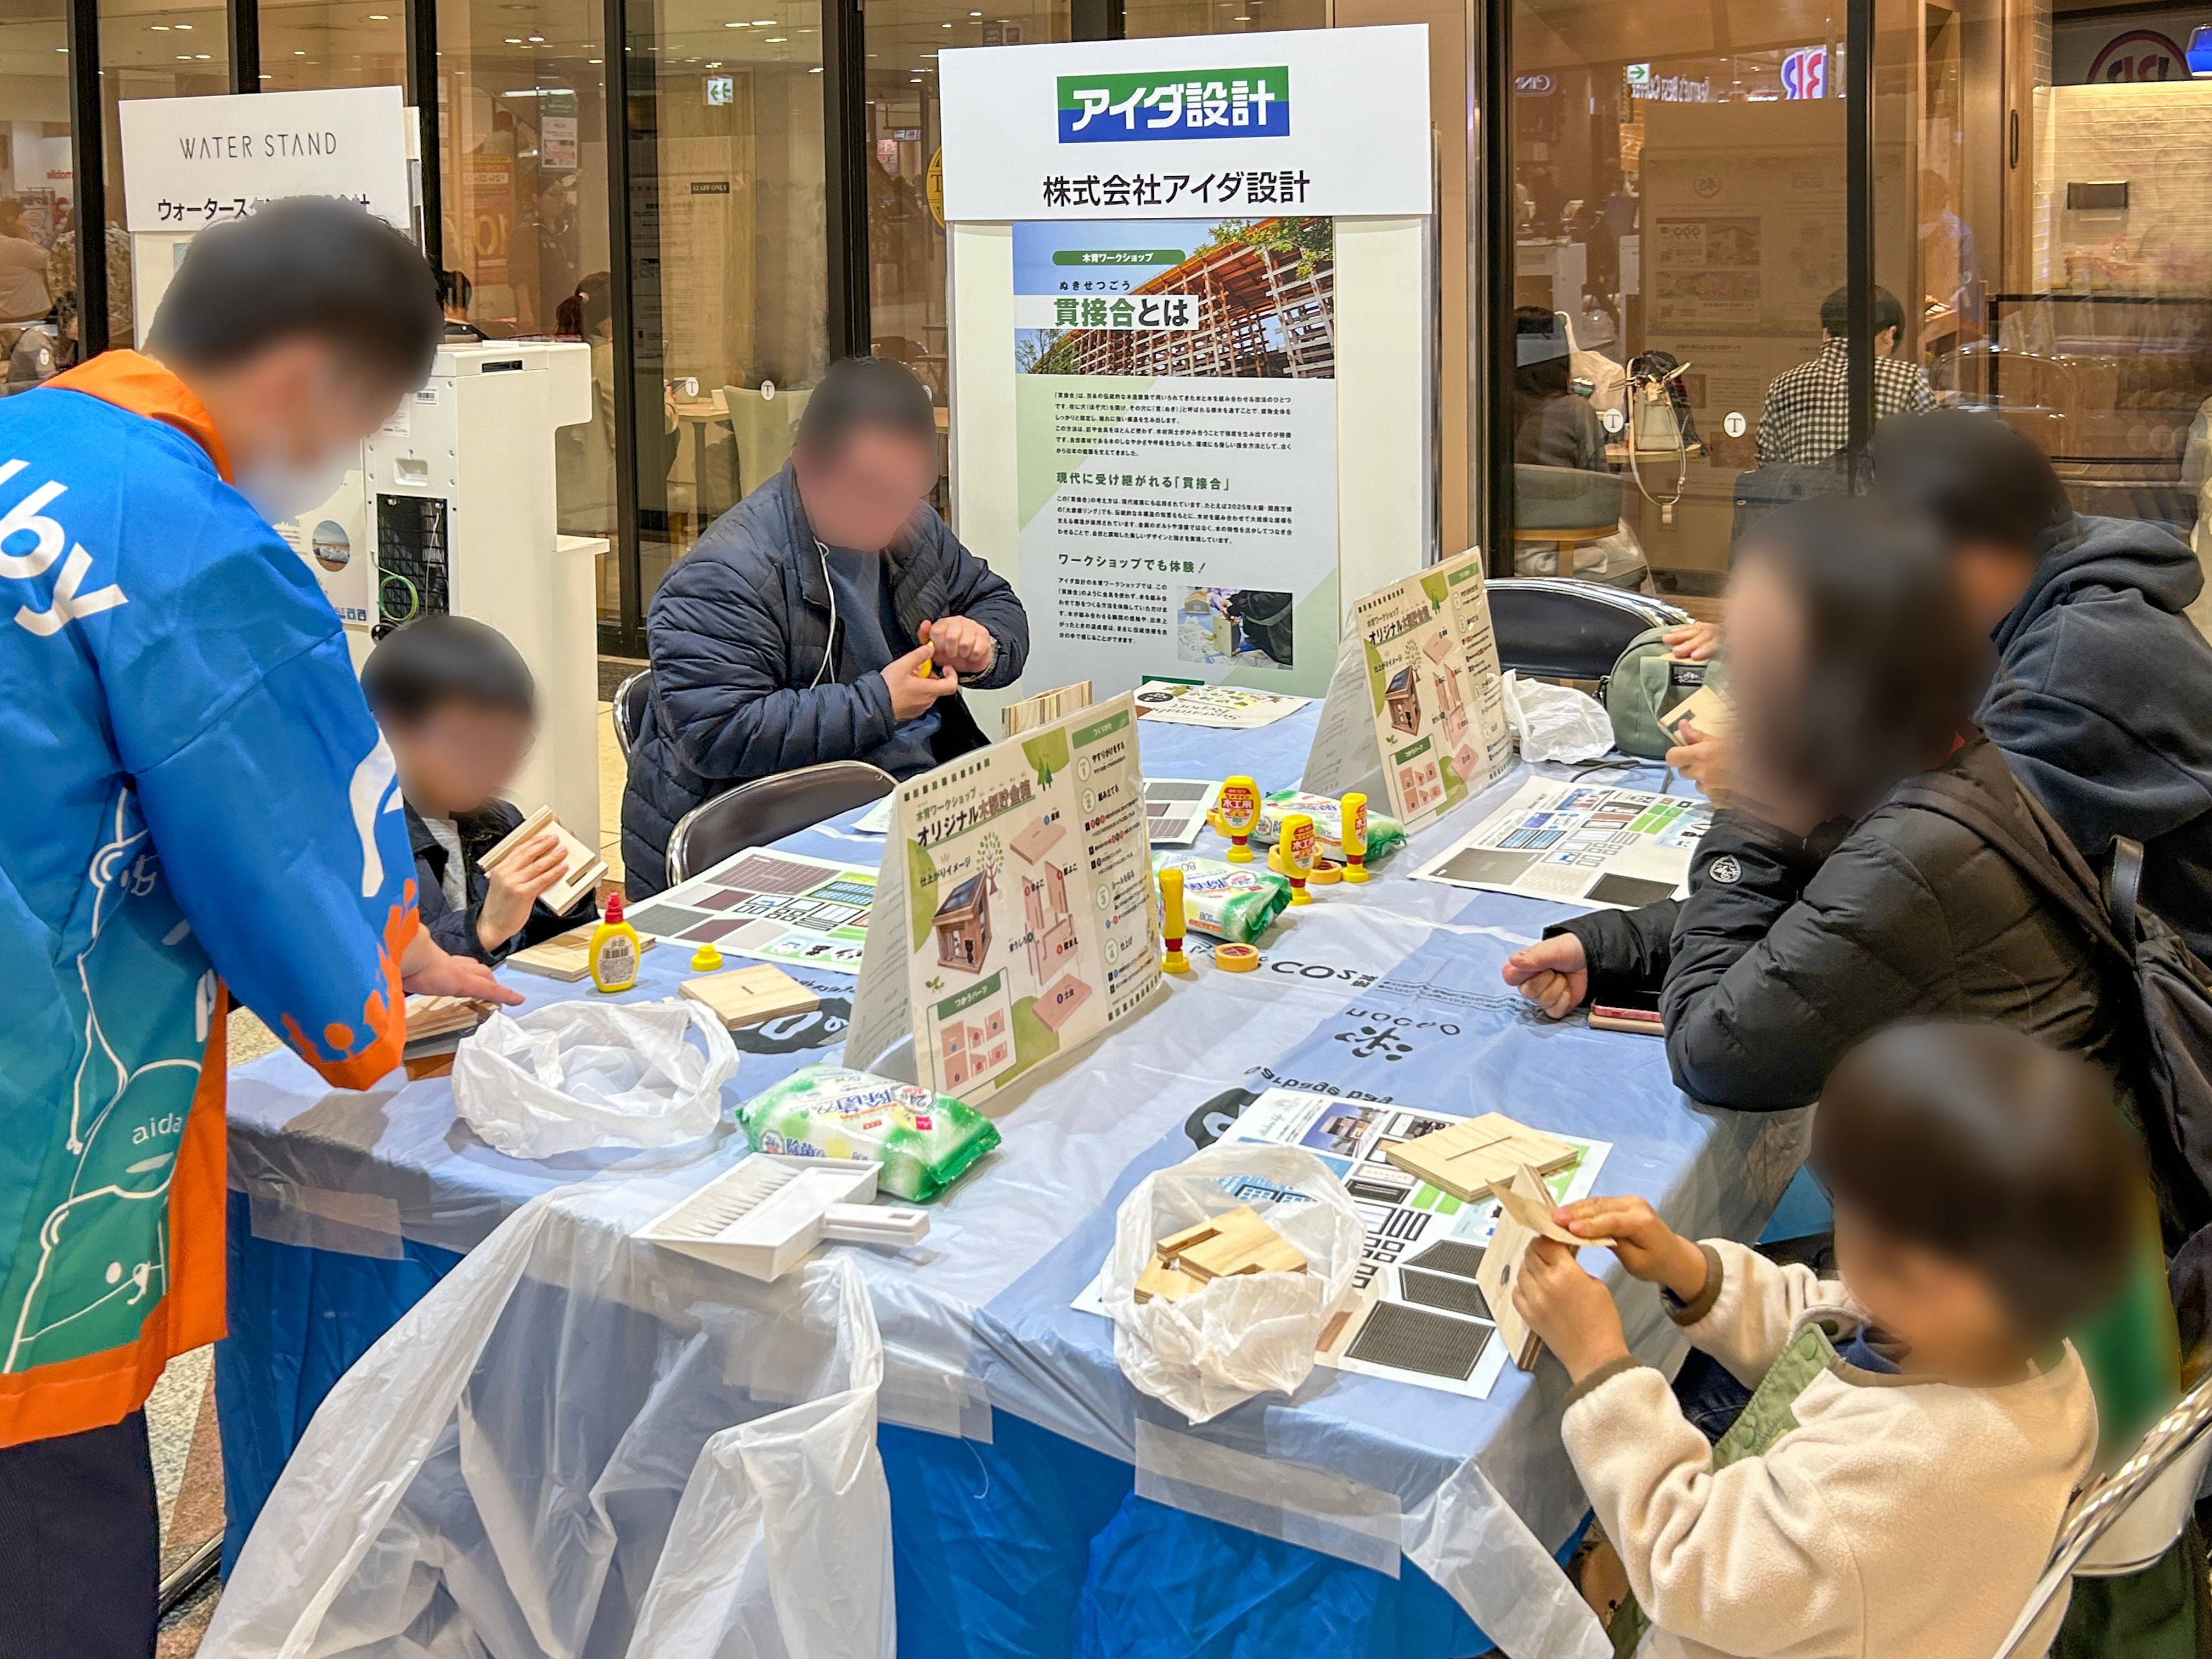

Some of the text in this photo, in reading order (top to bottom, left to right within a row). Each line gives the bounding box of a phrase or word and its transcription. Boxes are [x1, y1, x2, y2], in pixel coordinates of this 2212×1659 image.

[1073, 80, 1275, 131] アイダ設計
[180, 132, 337, 160] WATER STAND
[1043, 170, 1310, 207] 株式会社アイダ設計
[1082, 252, 1154, 263] 木育ワークショップ
[1059, 280, 1130, 291] ぬきせつごう
[1053, 298, 1190, 329] 貫接合とは
[1606, 414, 1622, 429] T
[1726, 417, 1742, 433] T
[1056, 472, 1229, 491] 現代に受け継がれる「貫接合」
[916, 787, 977, 822] 木育ワークショップ
[1223, 799, 1252, 809] 木工用
[132, 1111, 182, 1145] aida
